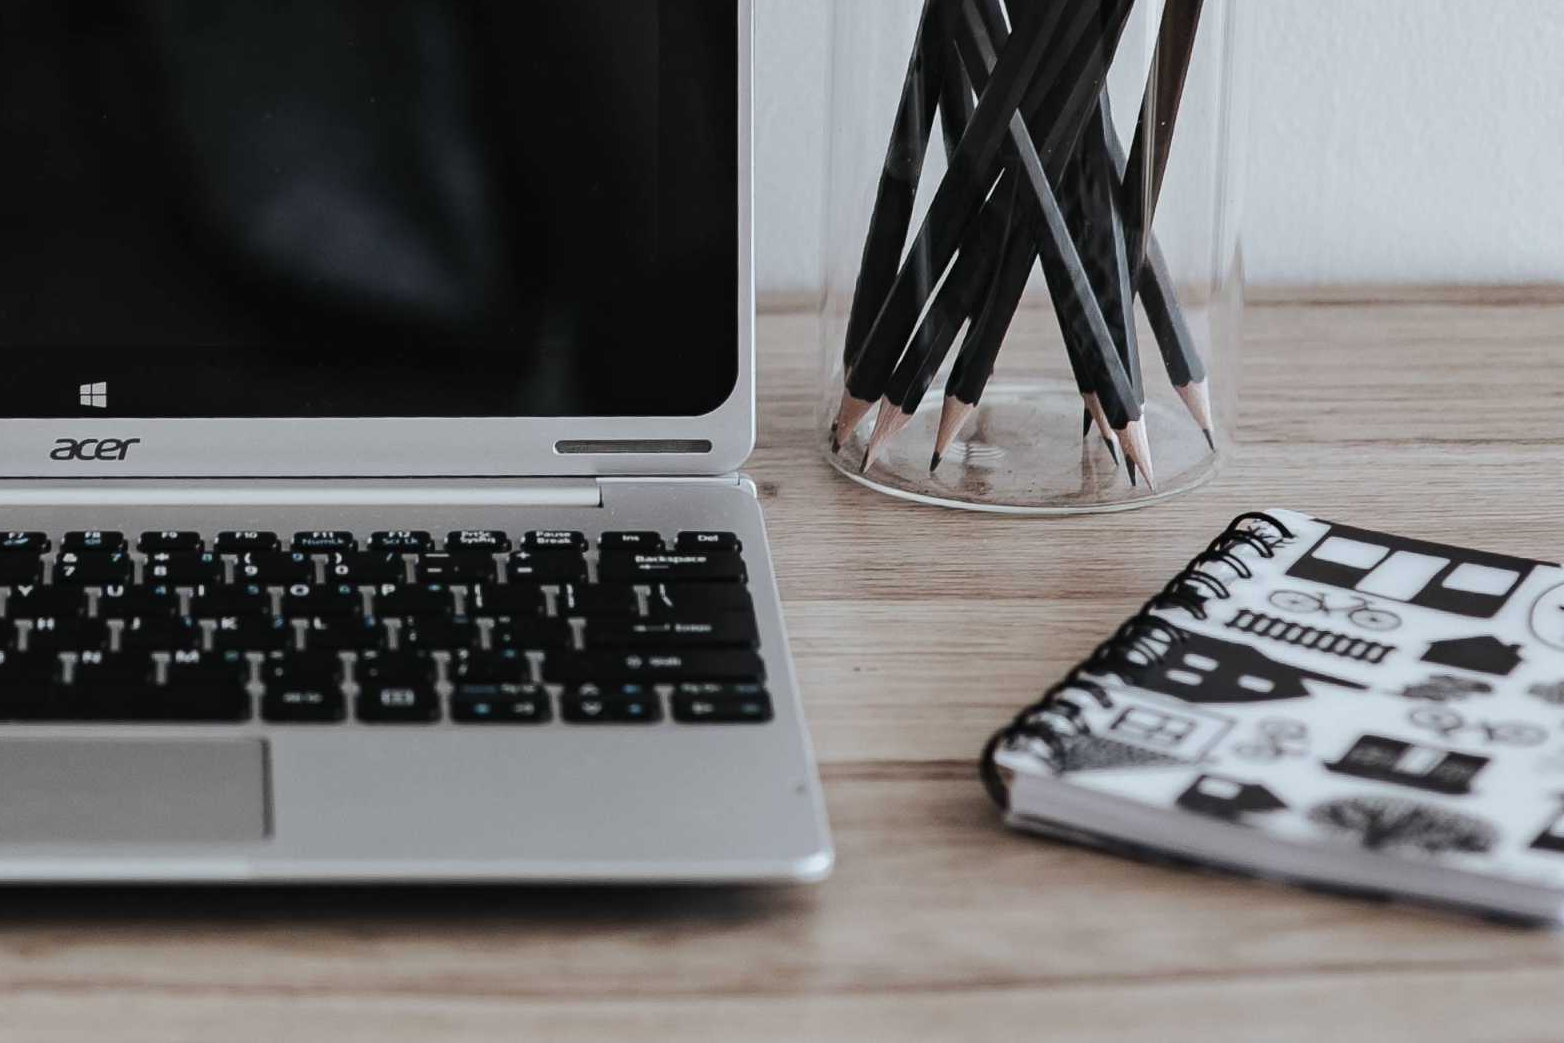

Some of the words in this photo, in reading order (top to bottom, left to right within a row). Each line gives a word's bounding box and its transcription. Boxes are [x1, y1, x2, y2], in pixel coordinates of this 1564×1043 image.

[50, 438, 140, 460] acer
[634, 555, 707, 564] Backspace
[17, 585, 34, 597] Y
[107, 585, 124, 597] U
[198, 585, 205, 597] I
[289, 584, 310, 596] O
[380, 584, 396, 596] P
[131, 616, 140, 630] J
[221, 616, 237, 630] K
[313, 617, 327, 630] L
[175, 650, 200, 663] M
